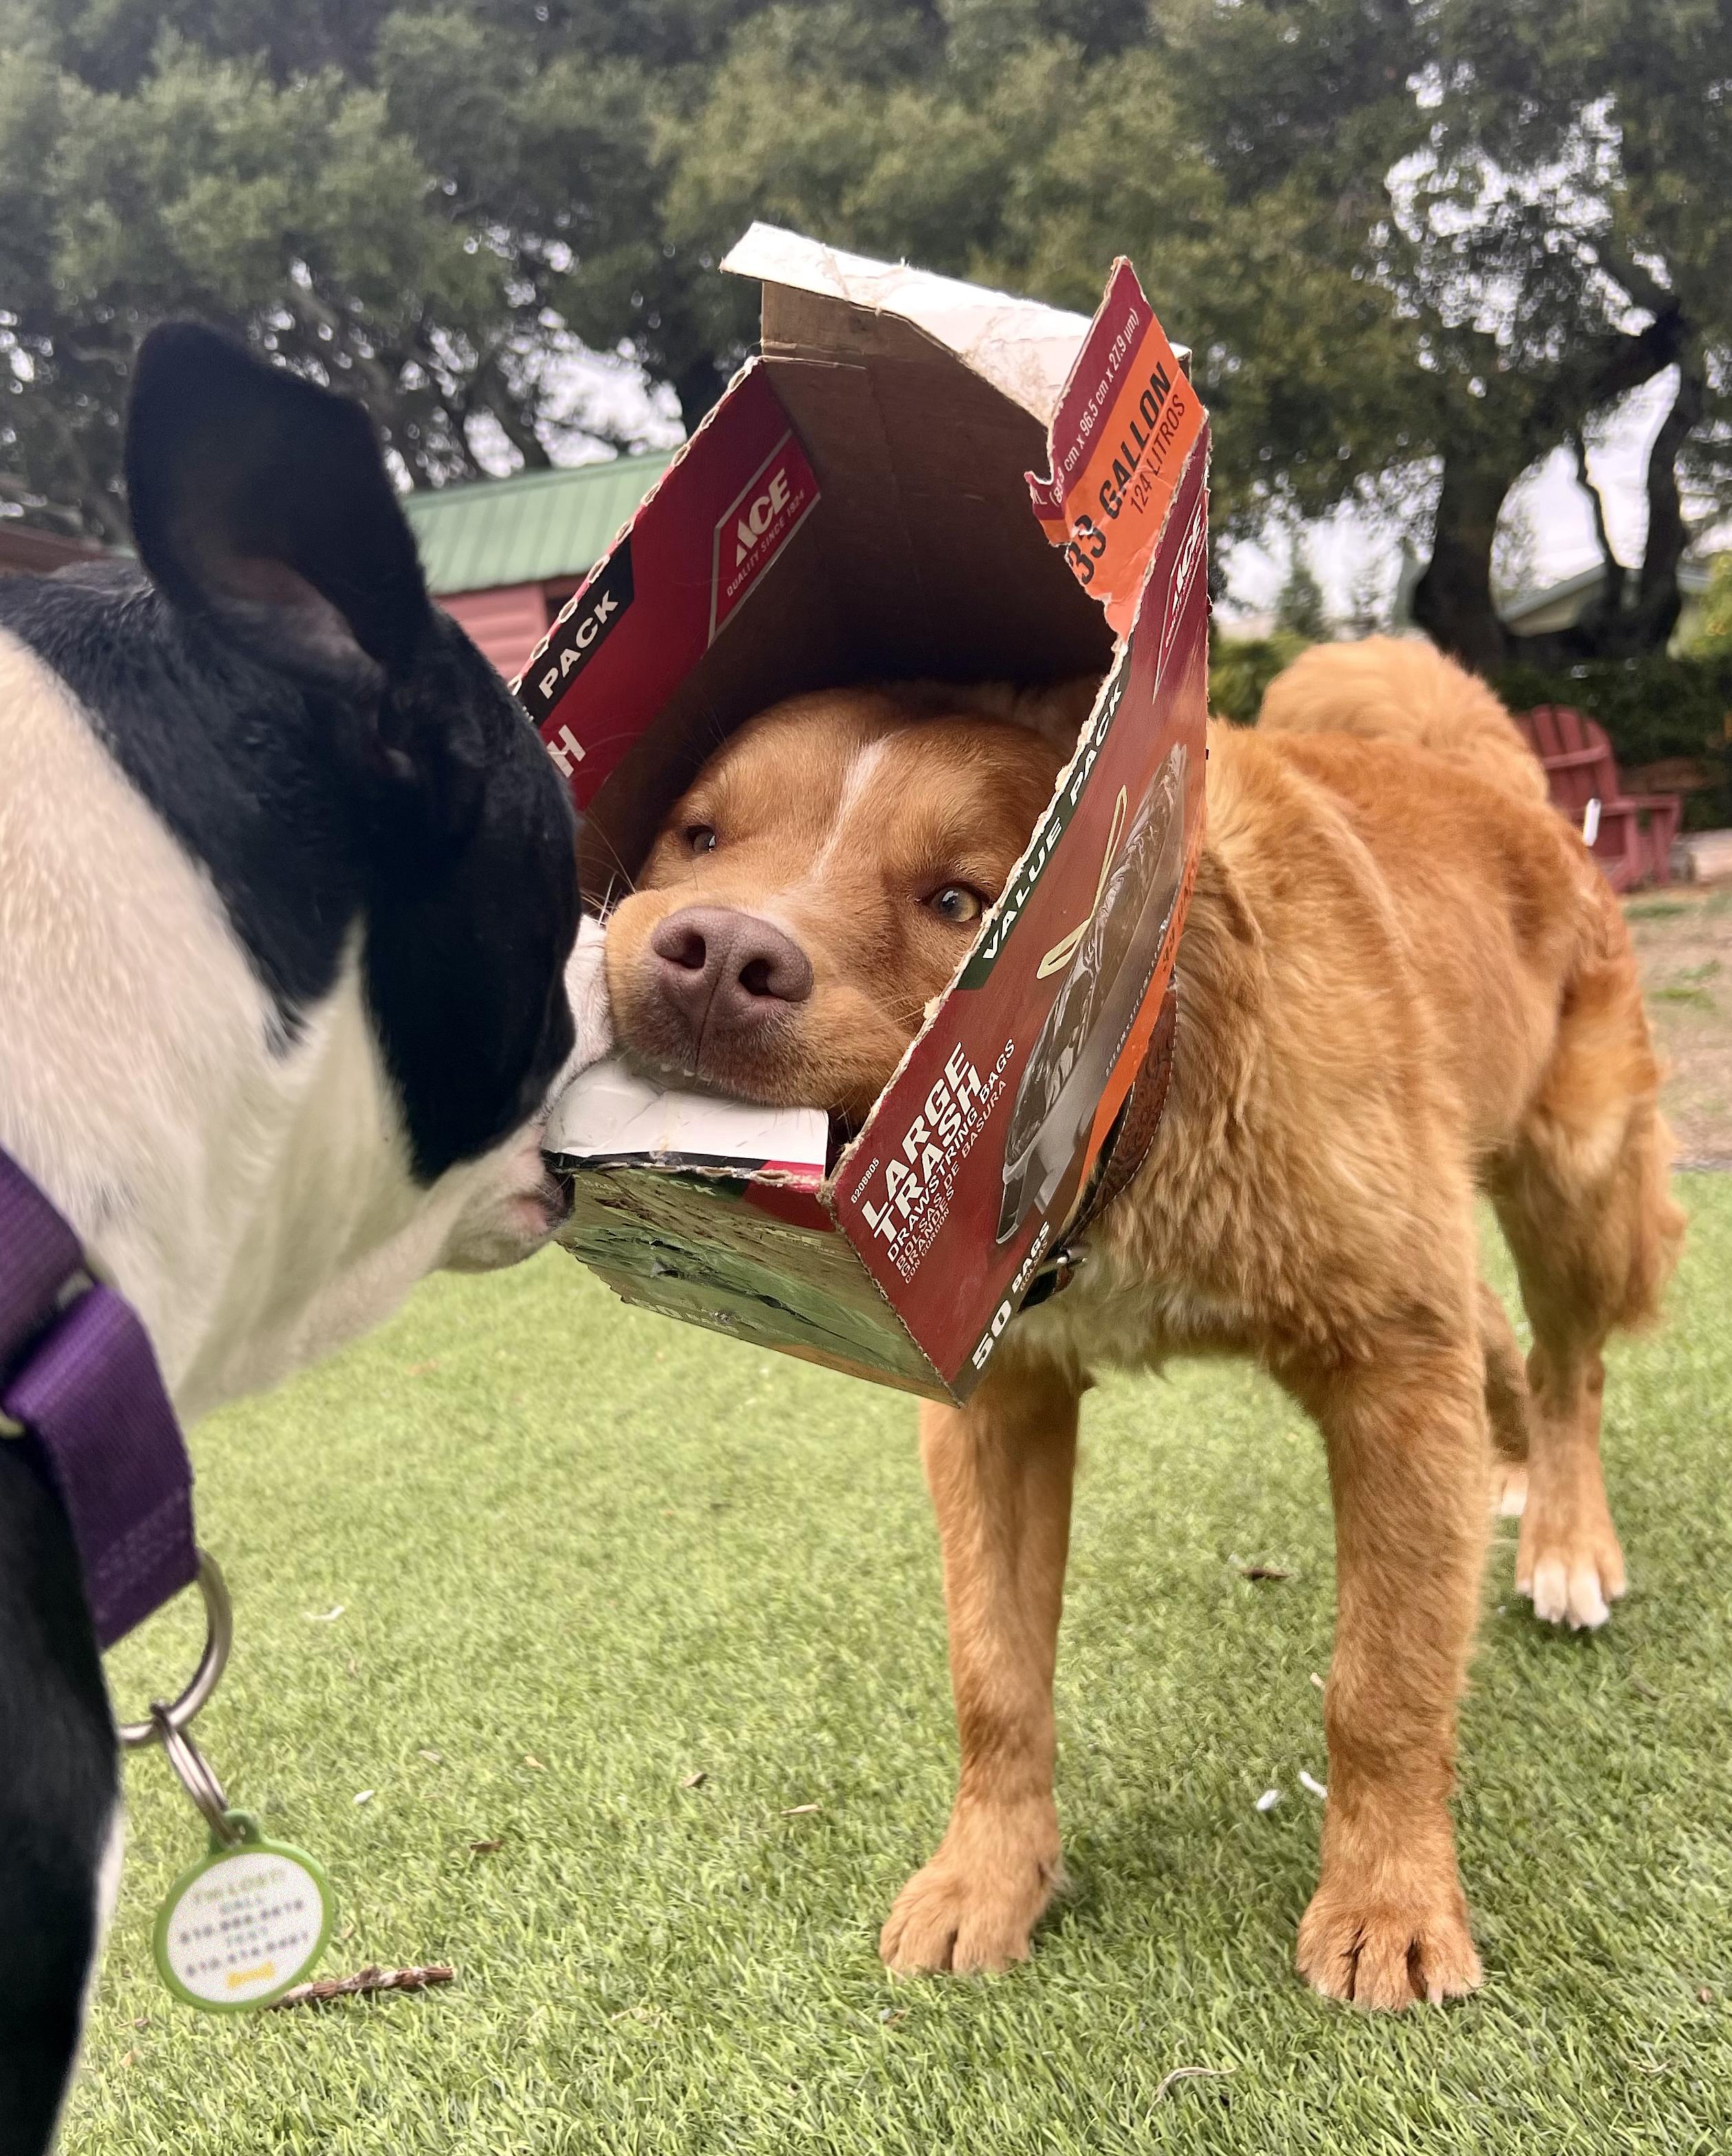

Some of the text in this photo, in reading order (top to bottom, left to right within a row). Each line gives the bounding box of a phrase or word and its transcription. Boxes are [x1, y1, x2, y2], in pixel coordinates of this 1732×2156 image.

[1096, 379, 1109, 405] cm
[1106, 366, 1114, 381] x
[1109, 335, 1126, 371] 27.9
[1065, 447, 1080, 472] cm
[1076, 434, 1085, 449] x
[1080, 399, 1098, 436] 96.5
[1100, 362, 1170, 520] GALLON
[1130, 394, 1185, 514] 124 LITROS
[726, 489, 805, 597] QUALITY SINCE 1924
[736, 467, 790, 567] ACE
[539, 590, 619, 700] PACK
[983, 680, 1122, 959] VALUE PACK
[851, 1157, 880, 1203] 6208805
[862, 1041, 970, 1230] LARGE
[874, 1065, 982, 1243] TRASH
[887, 1038, 1014, 1262] DRAWSTRING BAGS
[896, 1080, 1006, 1270] BOLSAS DE BASURA
[901, 1186, 954, 1277] GRANDES
[905, 1259, 920, 1284] CON
[972, 1221, 1050, 1370] 50 BAGS
